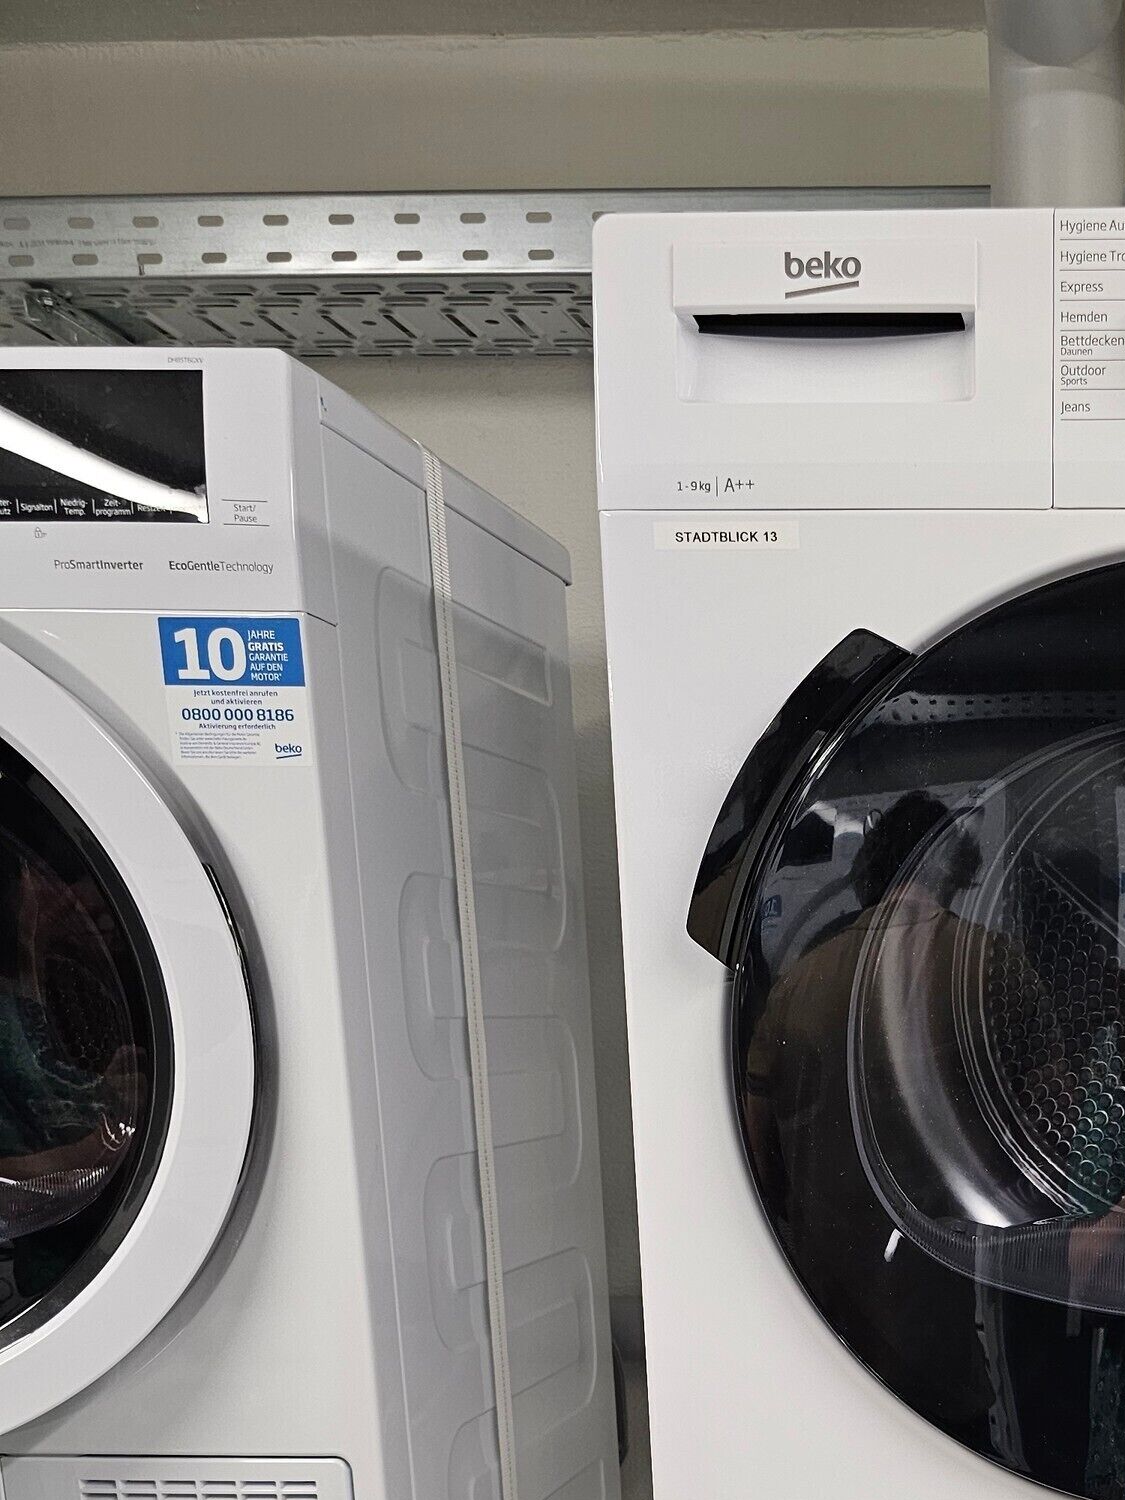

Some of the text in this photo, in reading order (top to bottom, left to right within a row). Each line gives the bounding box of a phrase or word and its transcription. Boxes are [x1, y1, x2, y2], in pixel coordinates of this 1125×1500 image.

[1060, 218, 1108, 233] Hygiene
[1060, 250, 1108, 263] Hygiene
[784, 251, 862, 279] beko
[1060, 281, 1104, 294] Express
[1060, 311, 1108, 323] Hemden
[1060, 335, 1125, 347] Bettdecken
[1060, 347, 1093, 356] Daunen
[1060, 365, 1106, 377] Outdoor
[1060, 377, 1088, 387] Sports
[1060, 401, 1091, 413] Jeans
[724, 477, 755, 493] A++
[95, 507, 131, 517] programm
[234, 514, 258, 523] Pause
[675, 531, 779, 544] STADTBLICK 13
[54, 560, 144, 571] ProSmartInverter
[169, 560, 274, 574] EcoGentleTechnology
[248, 630, 275, 641] JAHRE
[248, 642, 284, 652] GRATIS
[174, 627, 246, 681] 10
[249, 653, 289, 661] GARANTIE
[250, 662, 284, 671] AUF DEN
[182, 708, 294, 721] 0800 000 8186
[275, 743, 302, 754] beko
